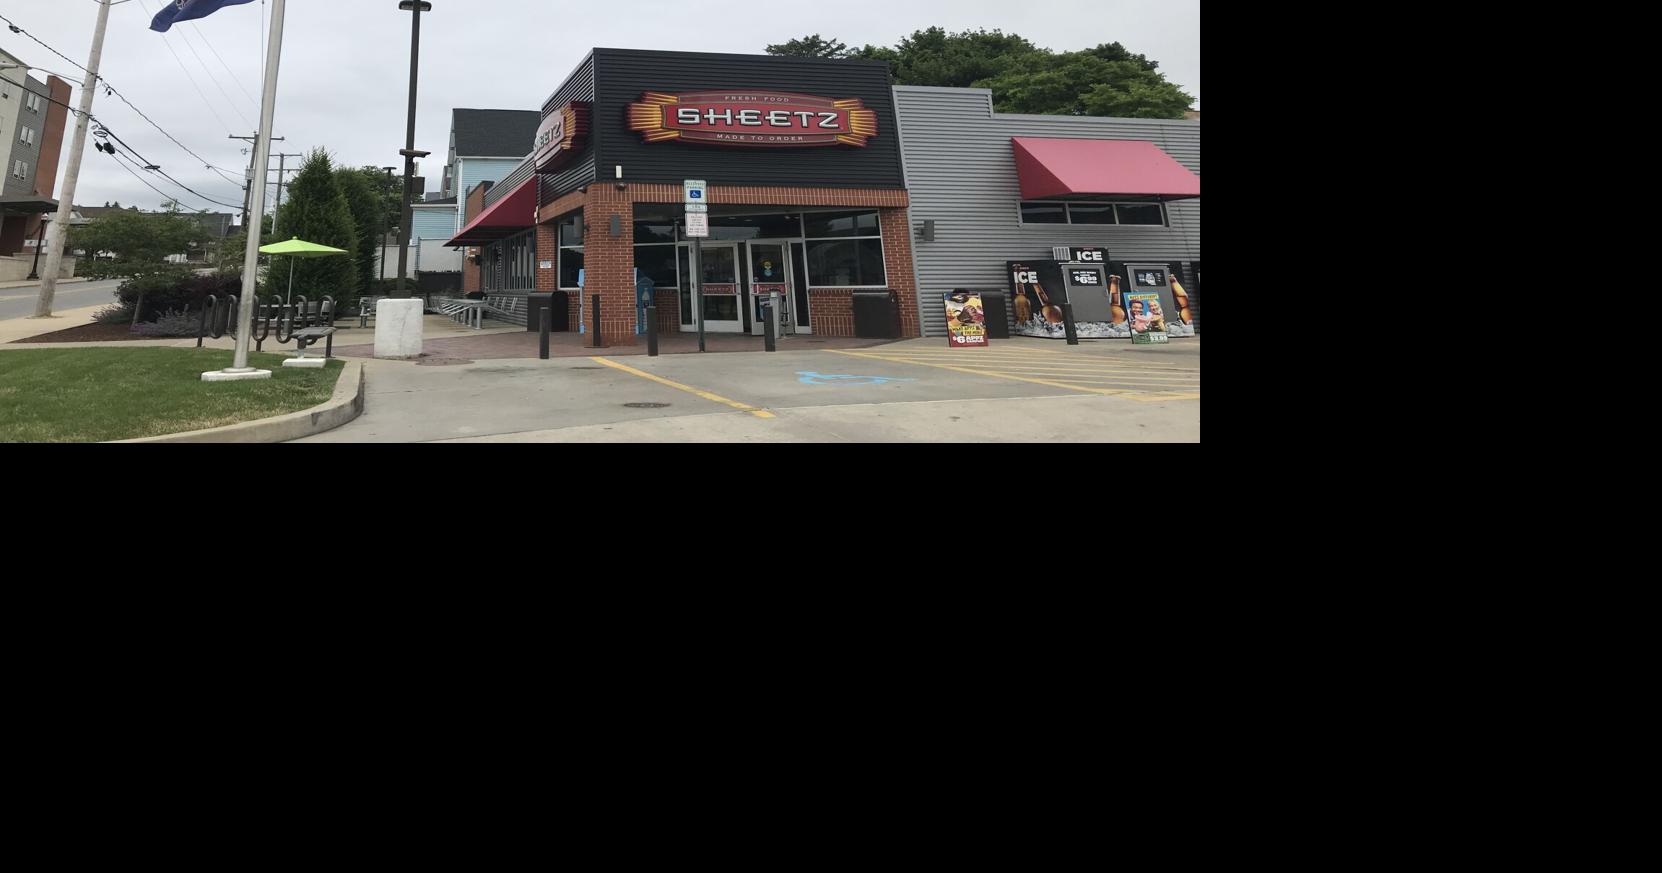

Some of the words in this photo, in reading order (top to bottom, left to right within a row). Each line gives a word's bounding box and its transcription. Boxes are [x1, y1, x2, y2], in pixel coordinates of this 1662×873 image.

[677, 108, 839, 128] SHEETZ
[1076, 251, 1103, 261] ICE
[1013, 271, 1039, 284] ICE
